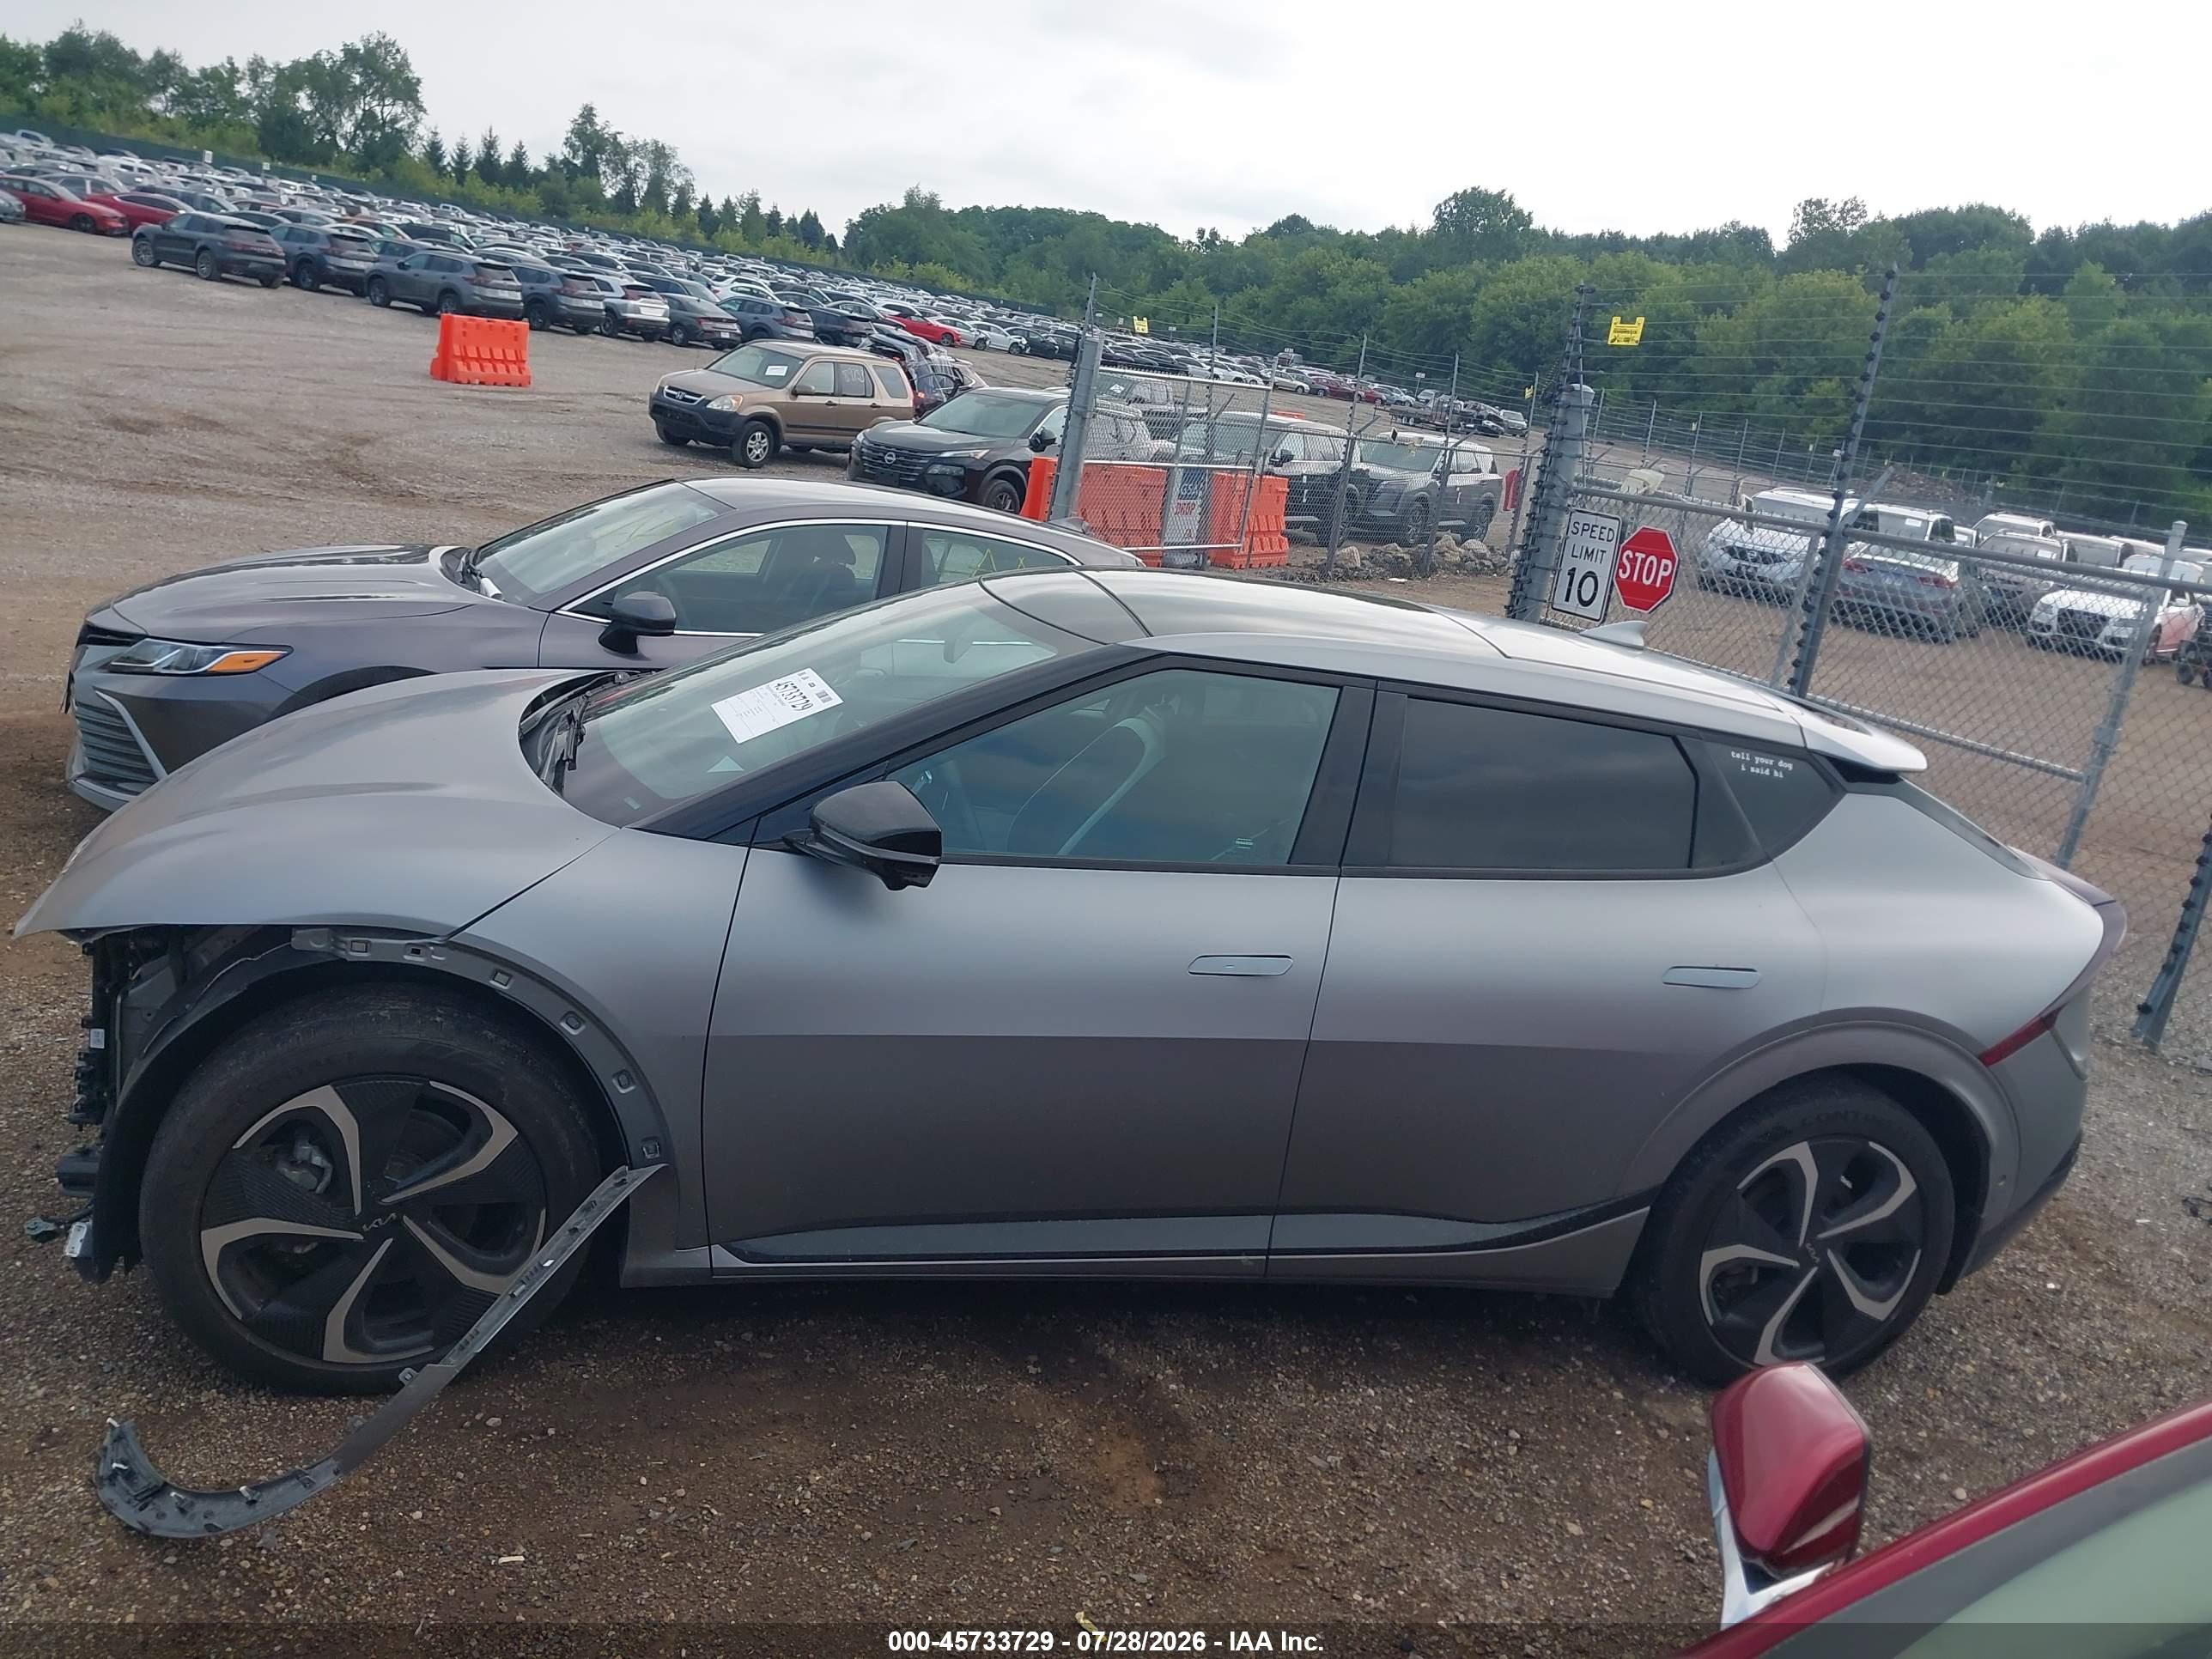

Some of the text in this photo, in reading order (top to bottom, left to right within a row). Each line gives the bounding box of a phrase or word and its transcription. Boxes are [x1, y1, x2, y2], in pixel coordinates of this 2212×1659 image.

[1571, 521, 1615, 543] SPEED
[1571, 543, 1607, 564] LIMIT
[1618, 550, 1673, 588] STOP
[1565, 567, 1599, 607] 10
[774, 680, 814, 712] 45733729
[1730, 750, 1794, 771] tell your dog
[1750, 766, 1771, 776] said
[1773, 769, 1784, 778] hi
